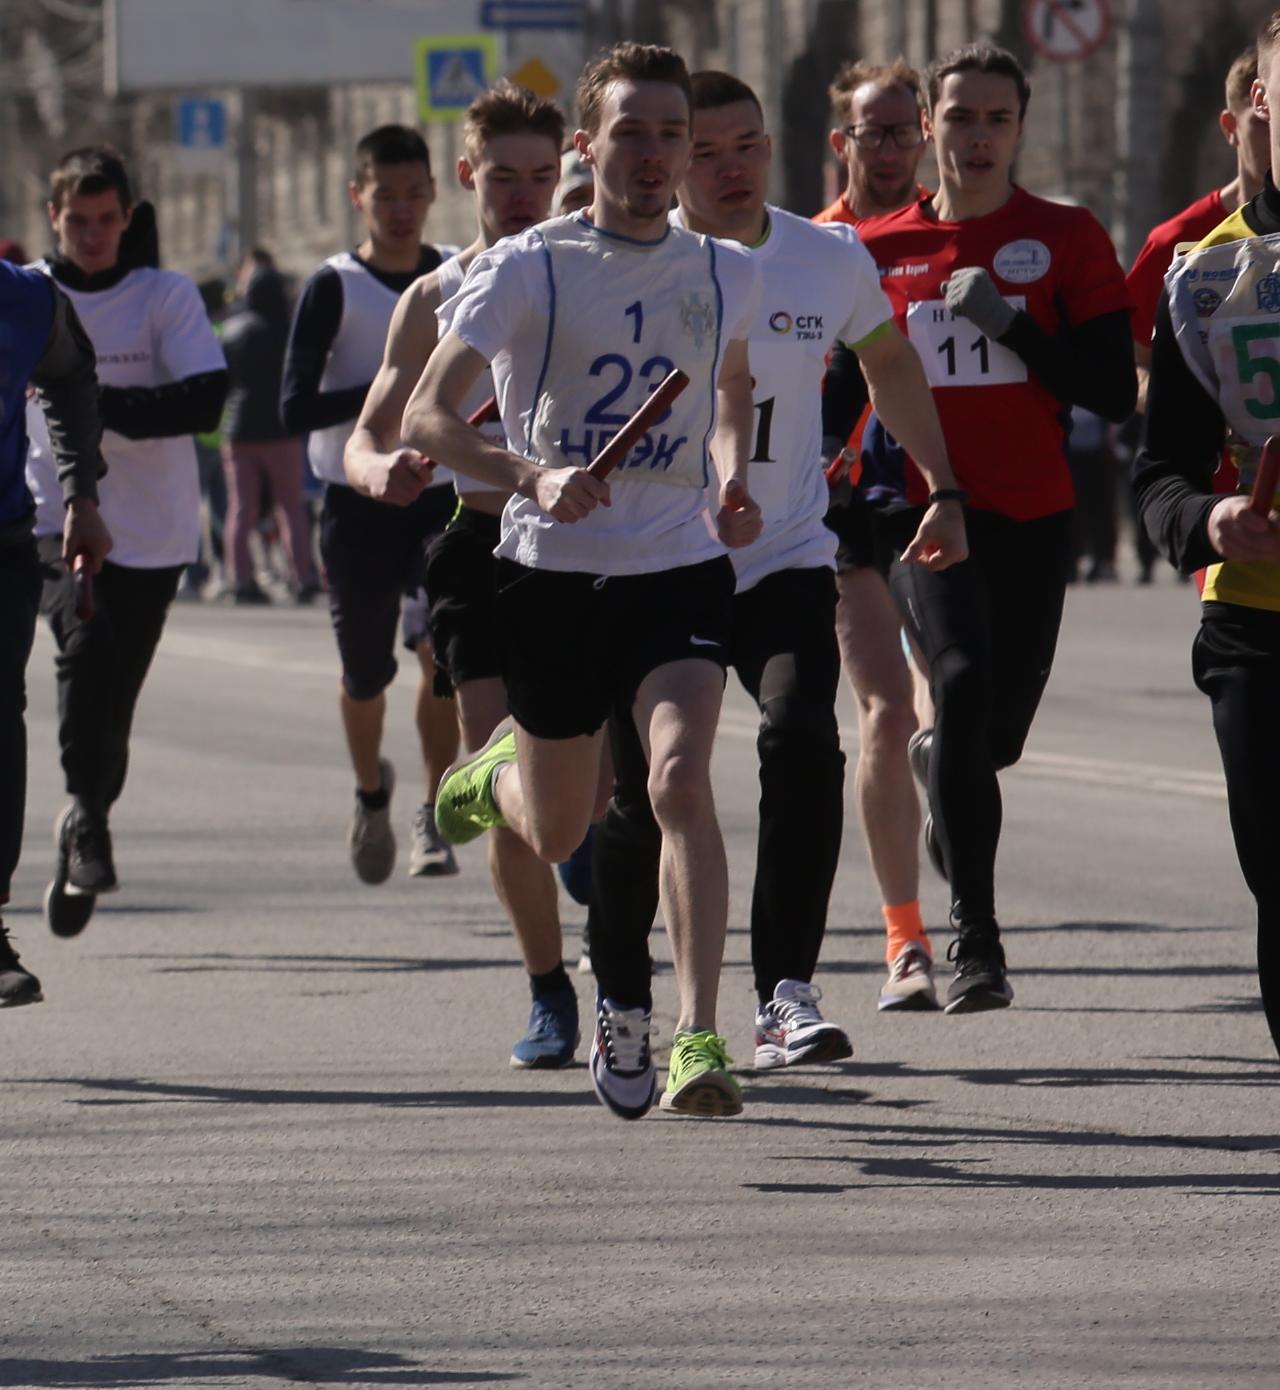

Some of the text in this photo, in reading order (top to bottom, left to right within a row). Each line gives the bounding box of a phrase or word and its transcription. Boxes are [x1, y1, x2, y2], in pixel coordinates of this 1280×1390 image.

[624, 301, 643, 344] 1
[796, 316, 823, 328] СГК
[938, 336, 989, 376] 11
[584, 353, 677, 427] 23
